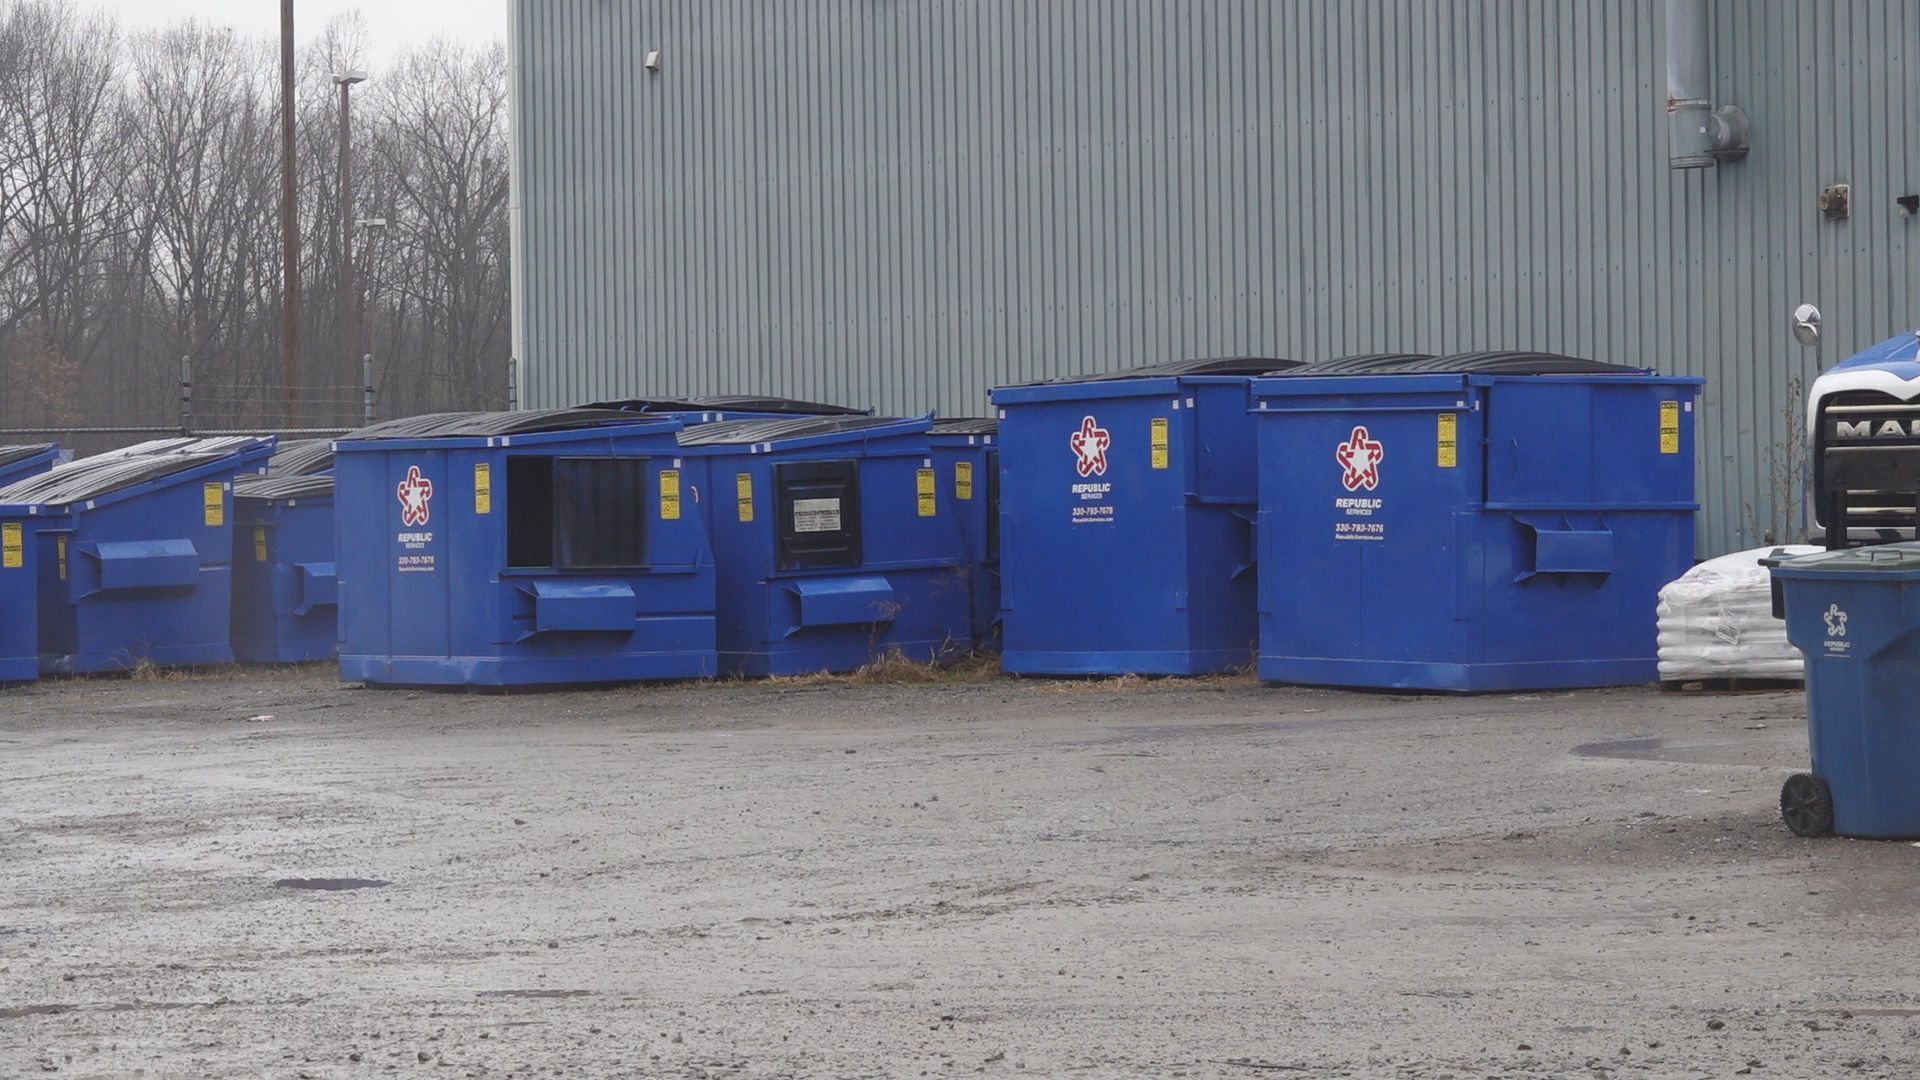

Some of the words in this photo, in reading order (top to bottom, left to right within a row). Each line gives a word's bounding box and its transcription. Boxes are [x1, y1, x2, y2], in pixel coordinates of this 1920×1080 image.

[1836, 420, 1920, 437] MA
[1072, 483, 1111, 493] REPUBLIC
[1335, 498, 1382, 508] REPUBLIC
[398, 532, 433, 543] REPUBLIC
